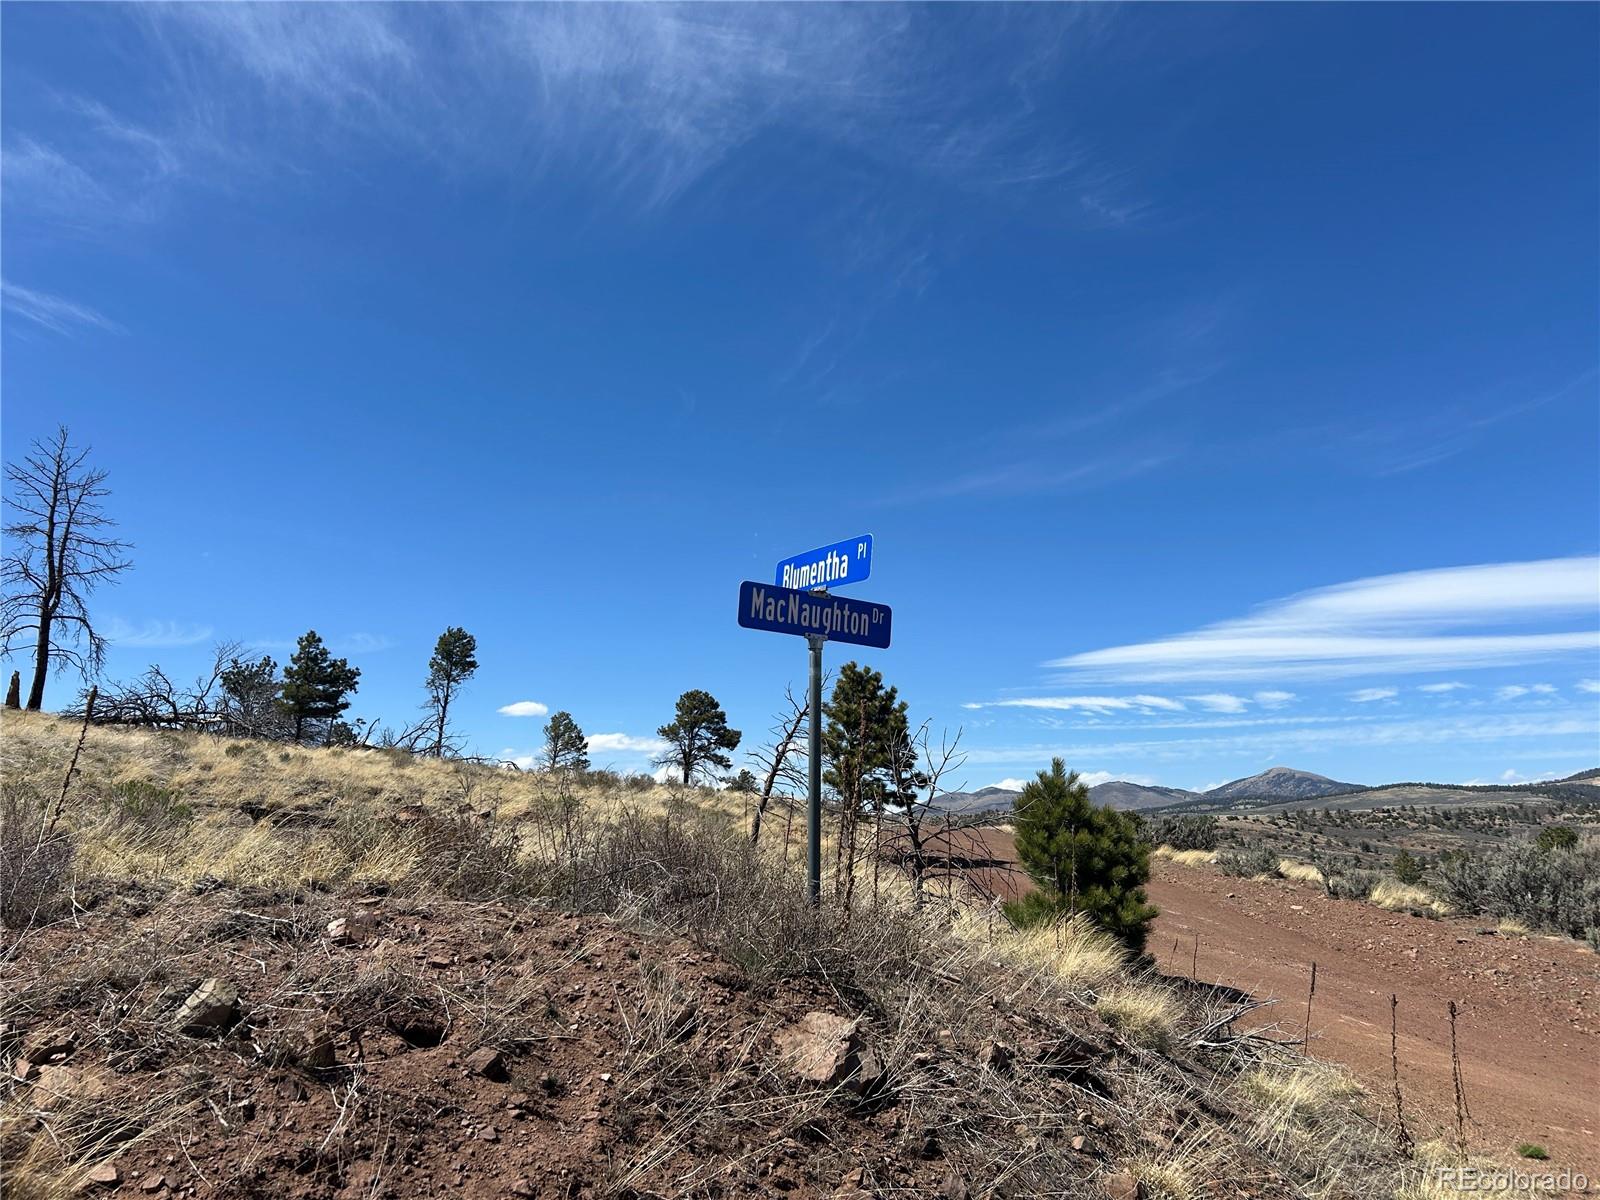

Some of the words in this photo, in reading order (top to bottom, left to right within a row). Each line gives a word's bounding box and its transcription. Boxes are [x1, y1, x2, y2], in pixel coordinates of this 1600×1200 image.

[782, 550, 849, 590] Blumentha
[857, 542, 867, 560] Pl
[751, 587, 869, 636] MacNaughton
[872, 607, 884, 625] Dr
